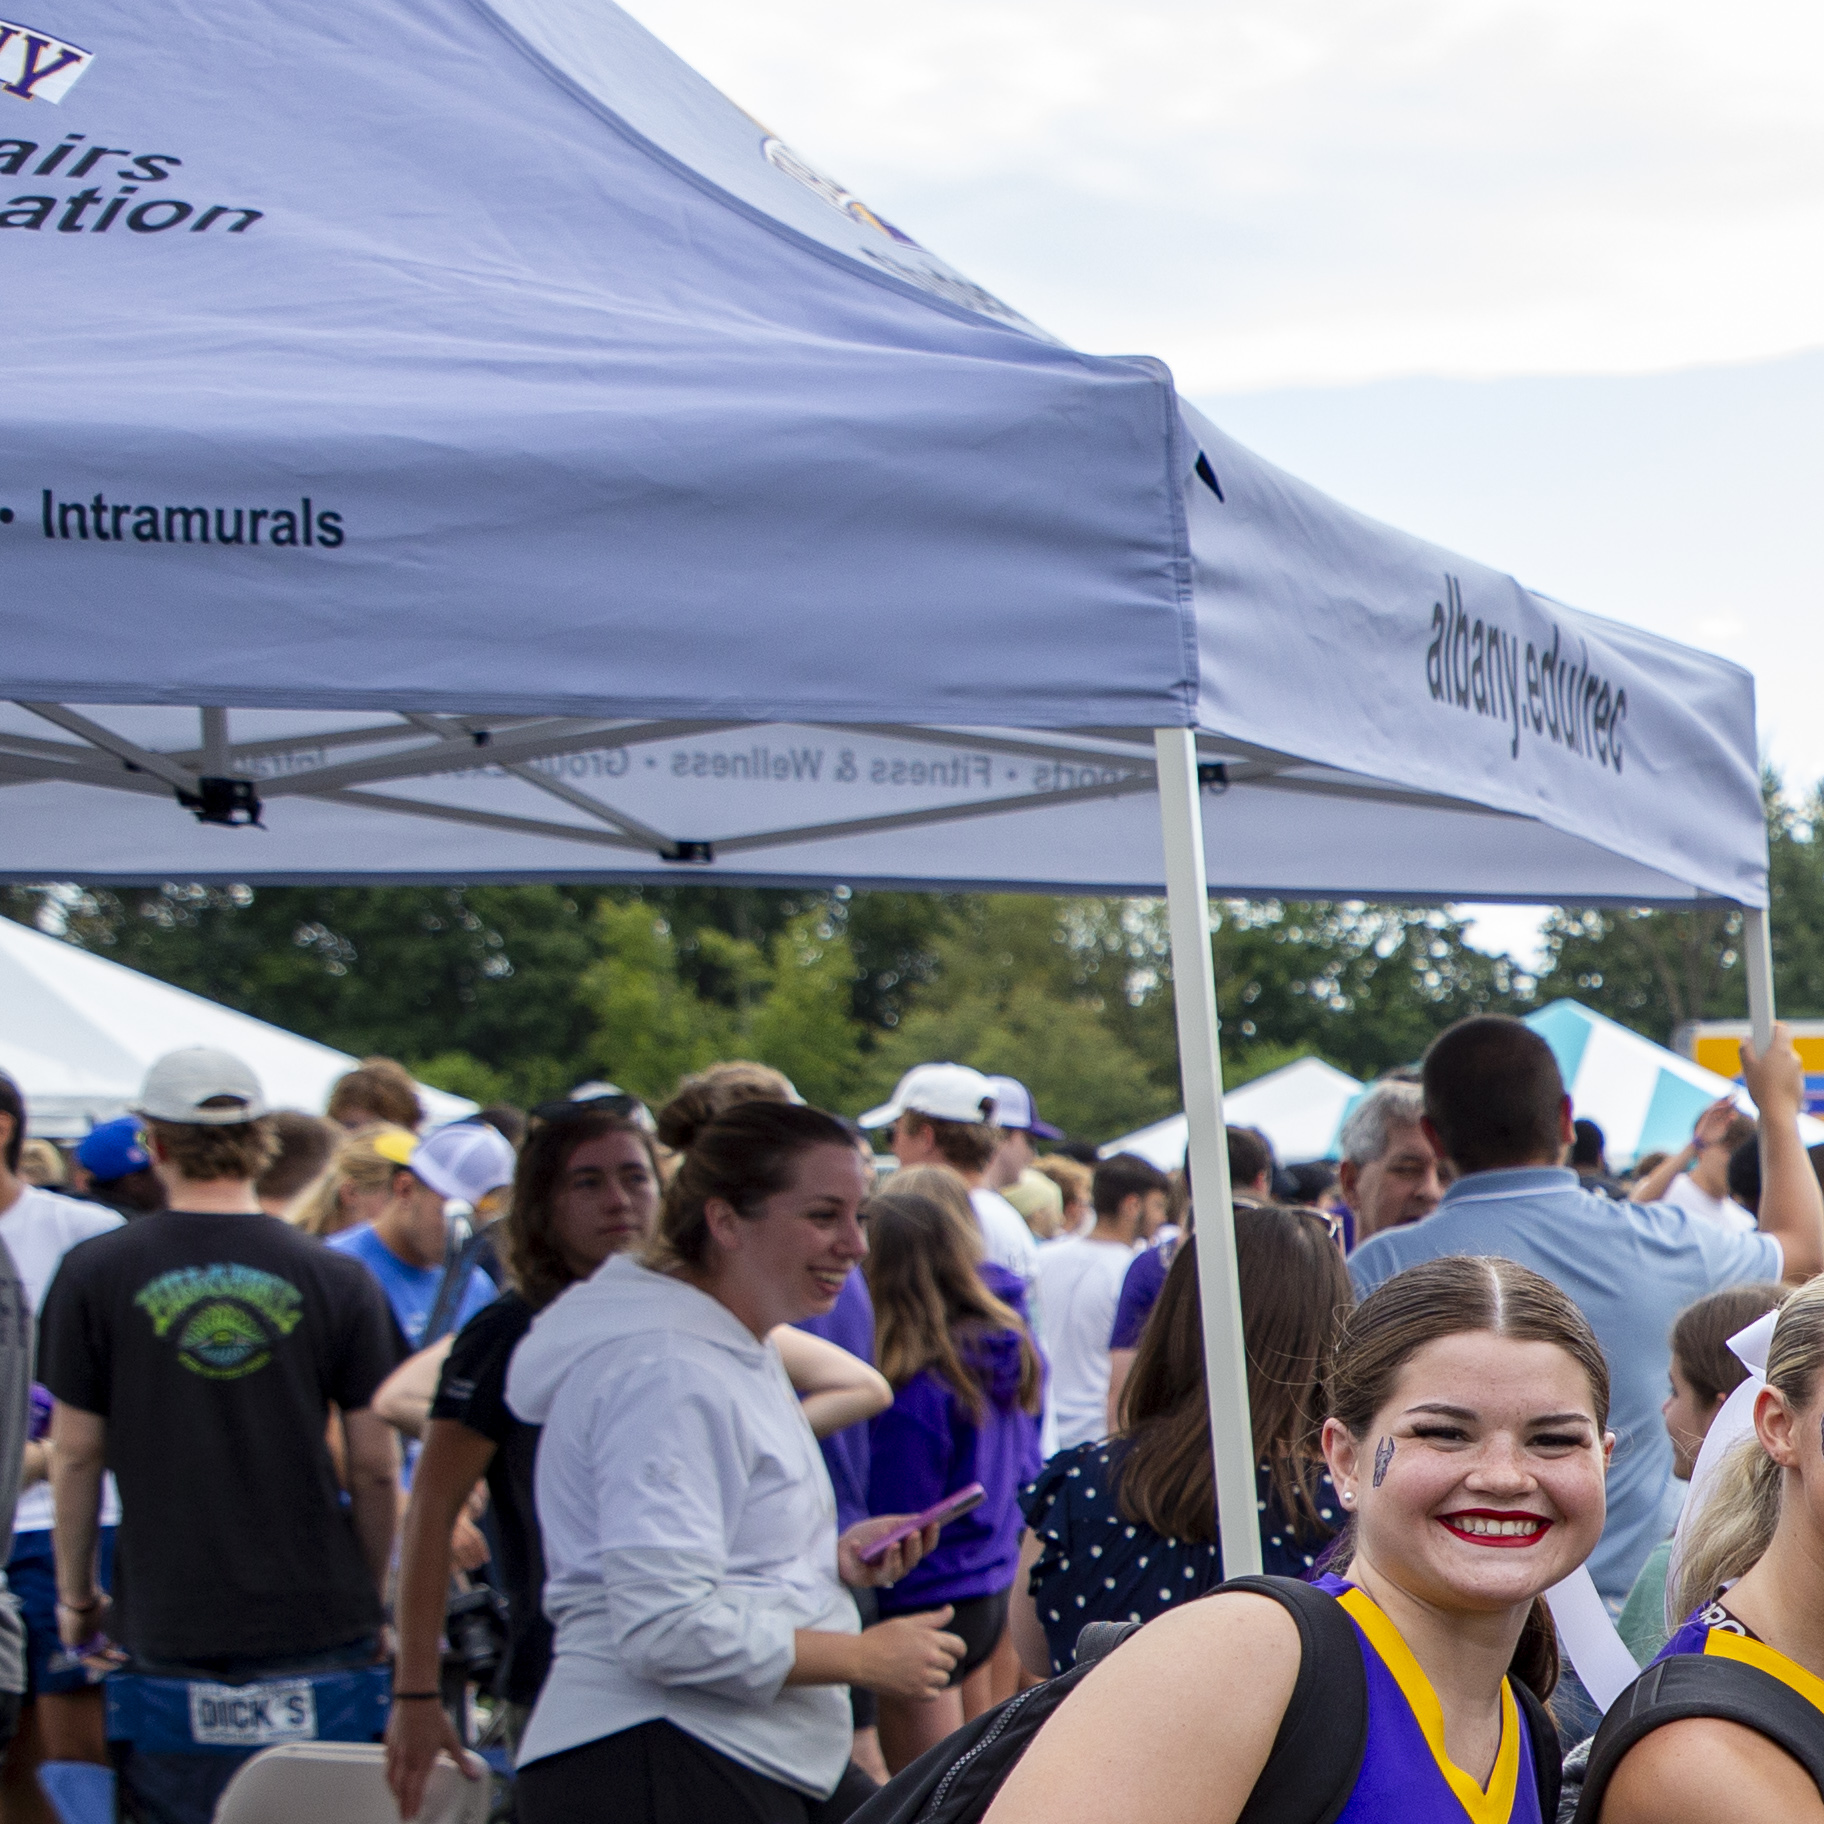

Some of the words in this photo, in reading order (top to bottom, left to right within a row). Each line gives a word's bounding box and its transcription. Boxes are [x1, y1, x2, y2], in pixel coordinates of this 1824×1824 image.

[0, 133, 183, 182] airs
[0, 185, 265, 234] ation
[41, 489, 346, 549] Intramurals
